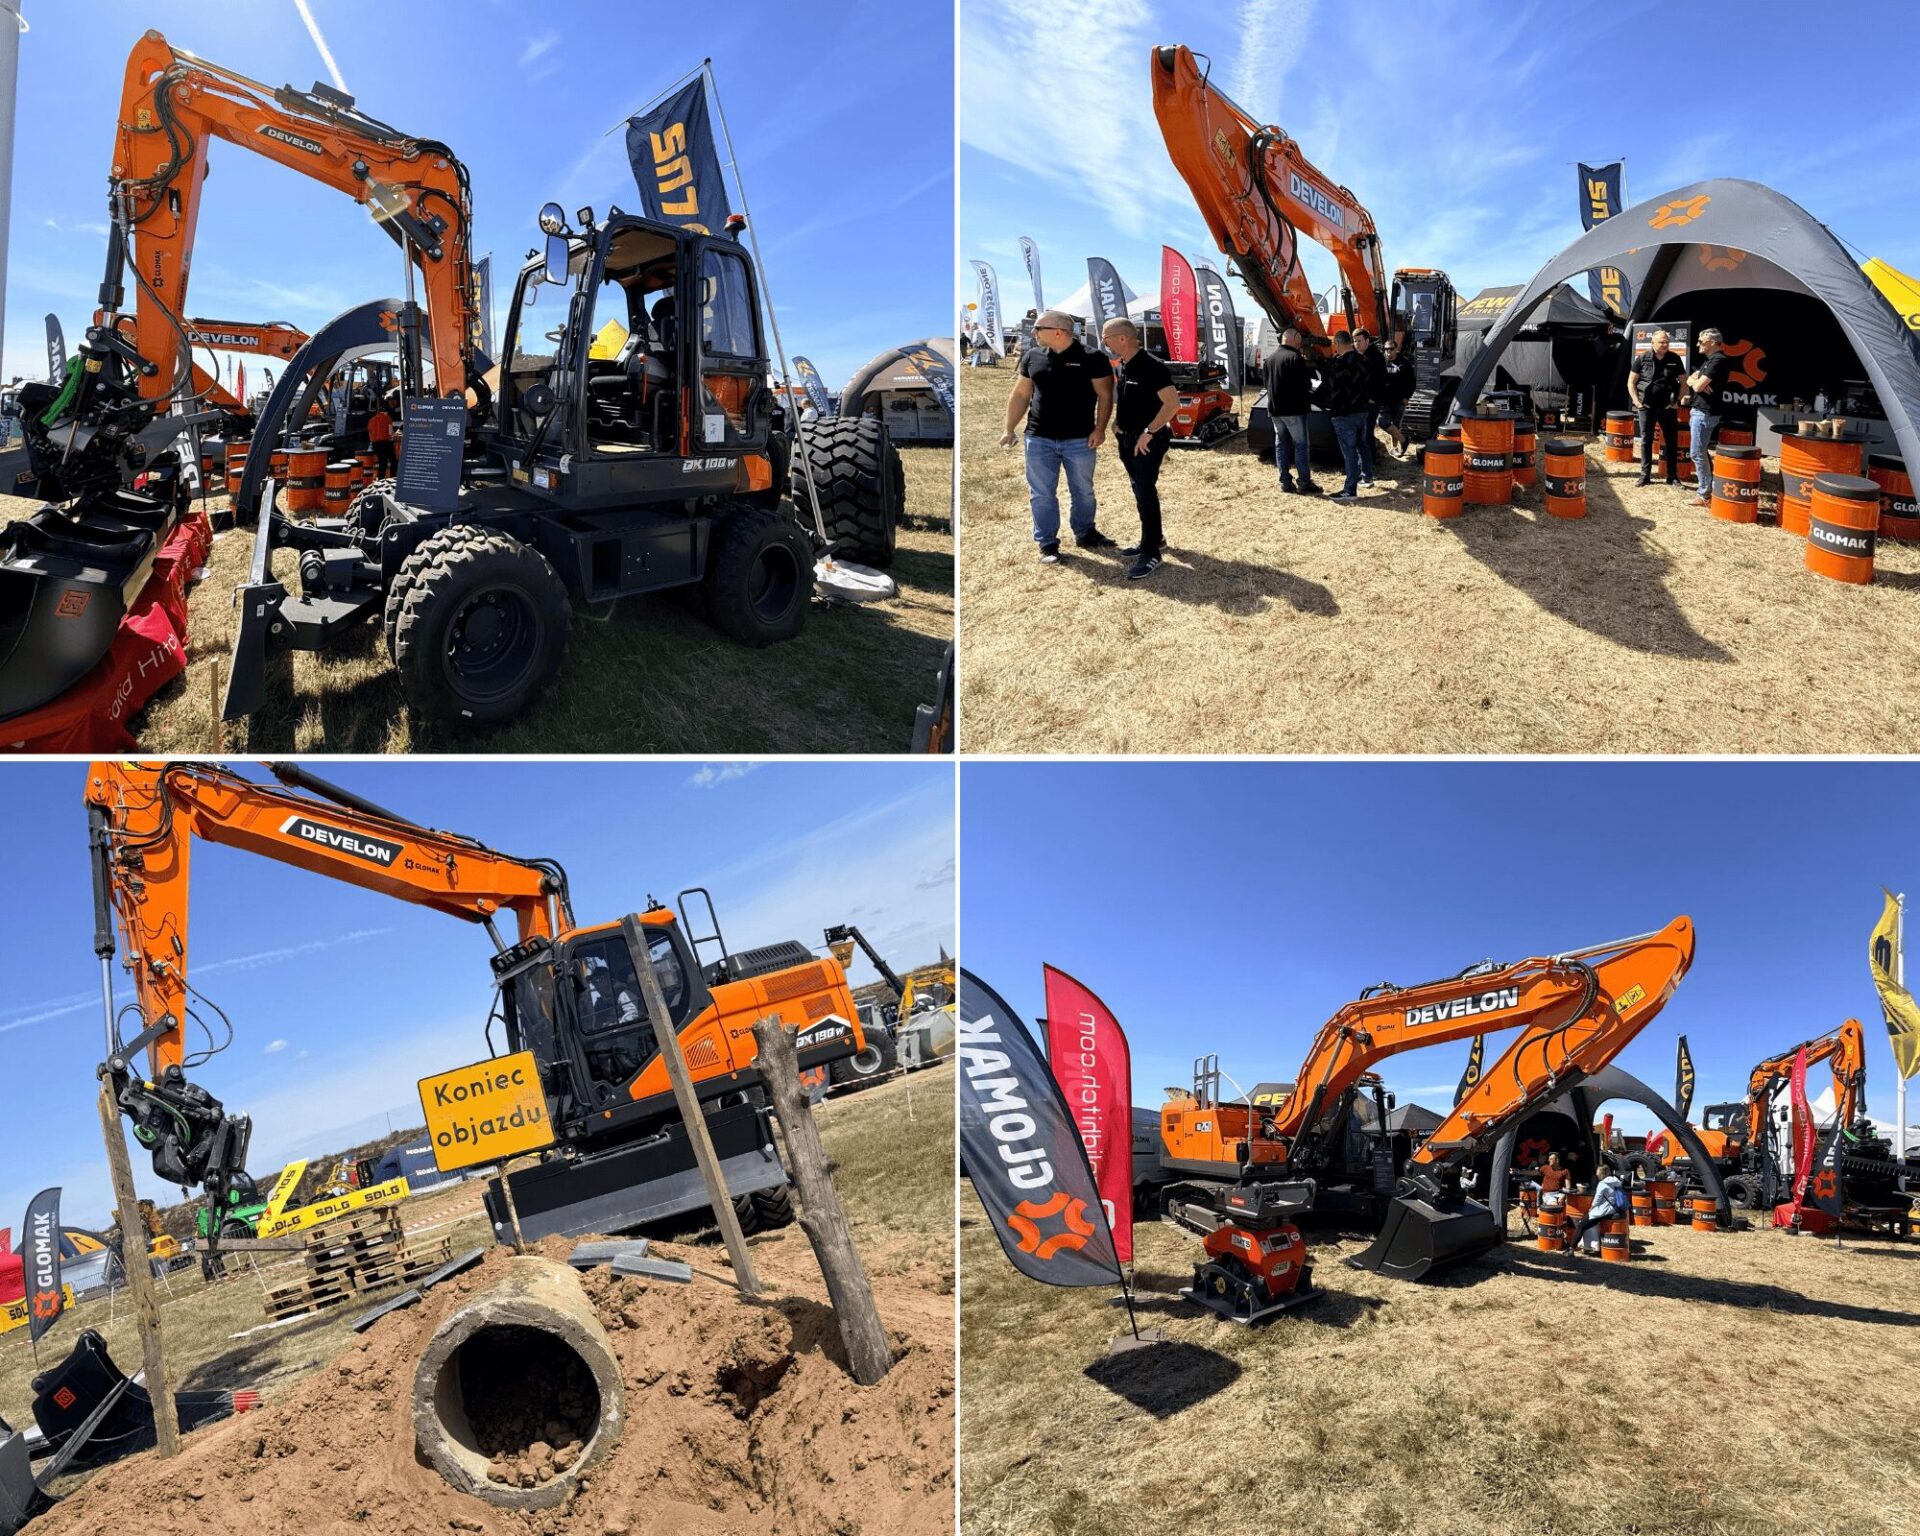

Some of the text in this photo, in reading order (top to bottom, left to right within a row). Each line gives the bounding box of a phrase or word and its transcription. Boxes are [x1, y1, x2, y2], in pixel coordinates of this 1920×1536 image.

[267, 128, 322, 154] DEVELON
[1290, 173, 1343, 227] DEVELON
[187, 331, 260, 347] DEVELON
[1722, 391, 1778, 405] OMAK
[1472, 458, 1504, 467] GLOMAK
[1813, 527, 1867, 549] GLOMAK
[300, 823, 391, 862] DEVELON
[415, 862, 440, 873] GLOMAK
[1406, 987, 1519, 1027] DEVELON
[434, 1068, 525, 1105] Koniec
[437, 1106, 541, 1145] objazdu
[315, 1200, 350, 1218] SDLG
[364, 1185, 400, 1202] SDLG
[34, 1212, 54, 1287] GLOMAK
[9, 1306, 28, 1321] SDL
